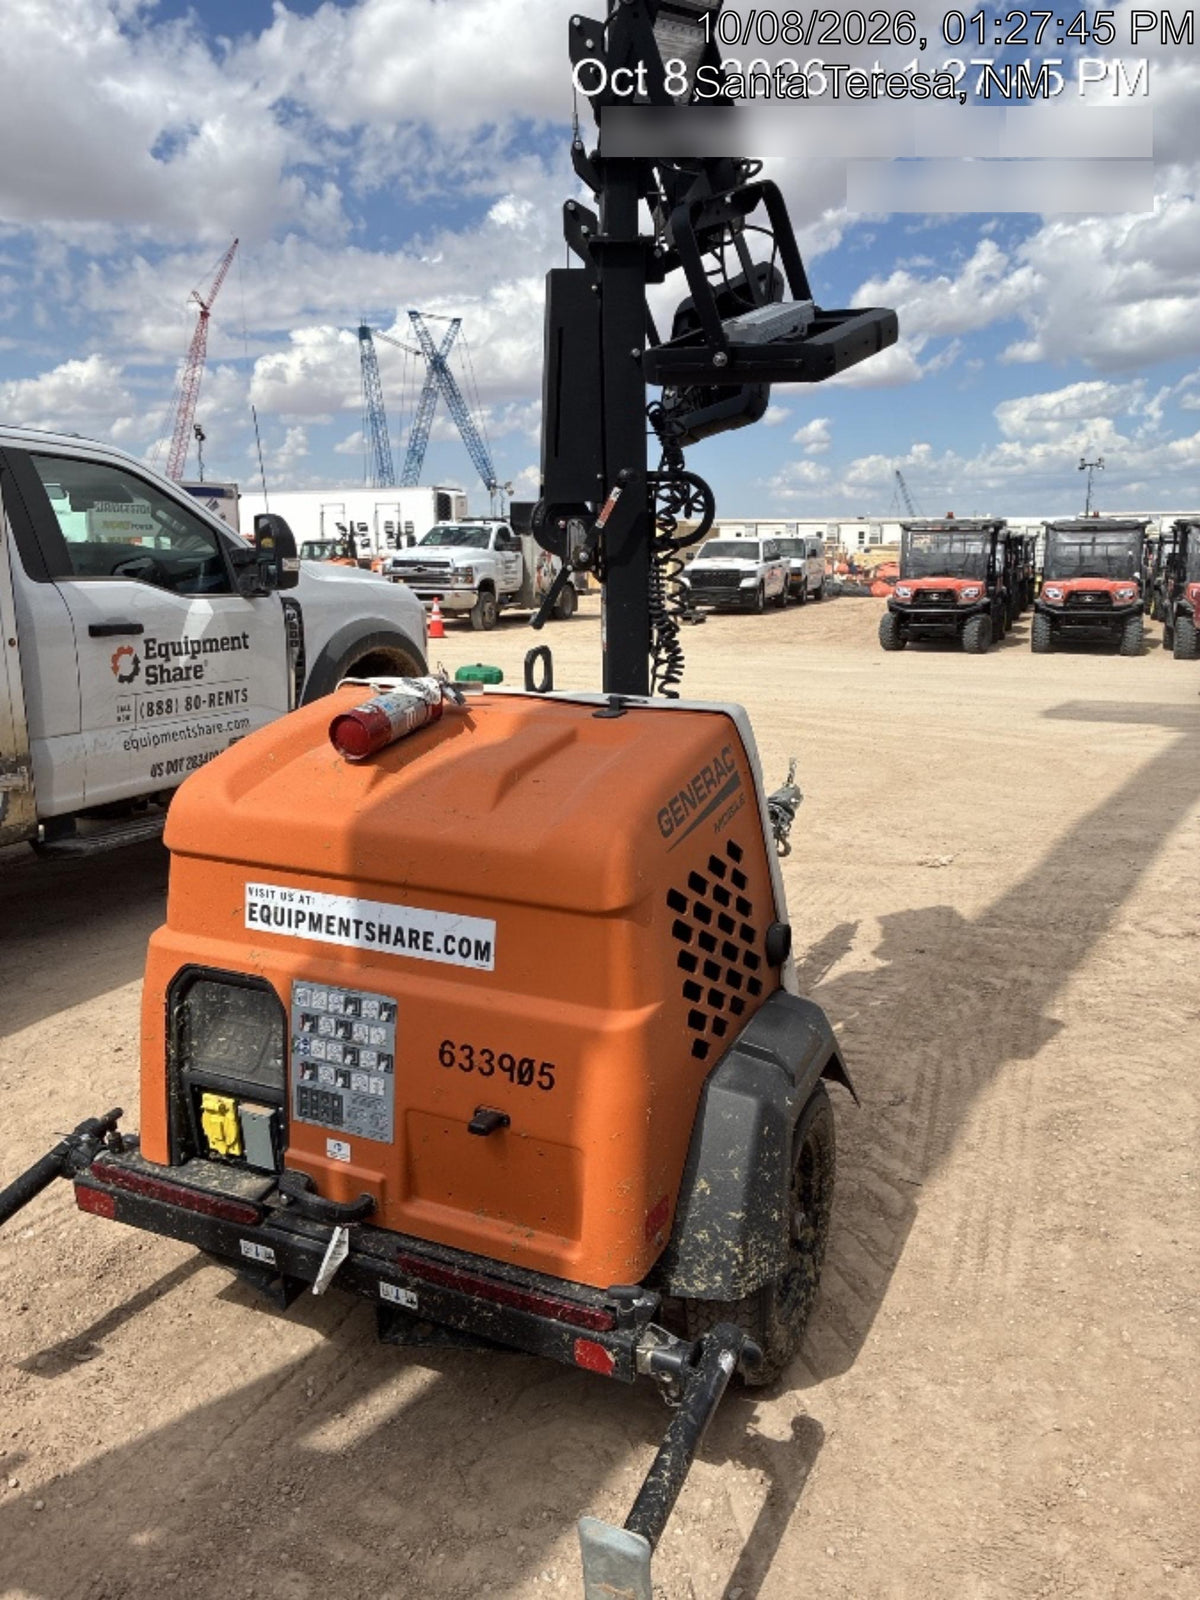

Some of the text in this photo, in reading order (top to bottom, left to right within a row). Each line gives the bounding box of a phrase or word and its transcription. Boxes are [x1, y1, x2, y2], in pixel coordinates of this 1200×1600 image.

[144, 633, 249, 662] Equipment
[140, 687, 249, 720] (888) 80-RENTS
[123, 717, 250, 752] equipmentshare.com
[657, 745, 736, 838] GENERAC
[248, 886, 276, 900] VISIT
[280, 891, 295, 902] US
[247, 902, 492, 963] EQUIPMENTSHARE.COM
